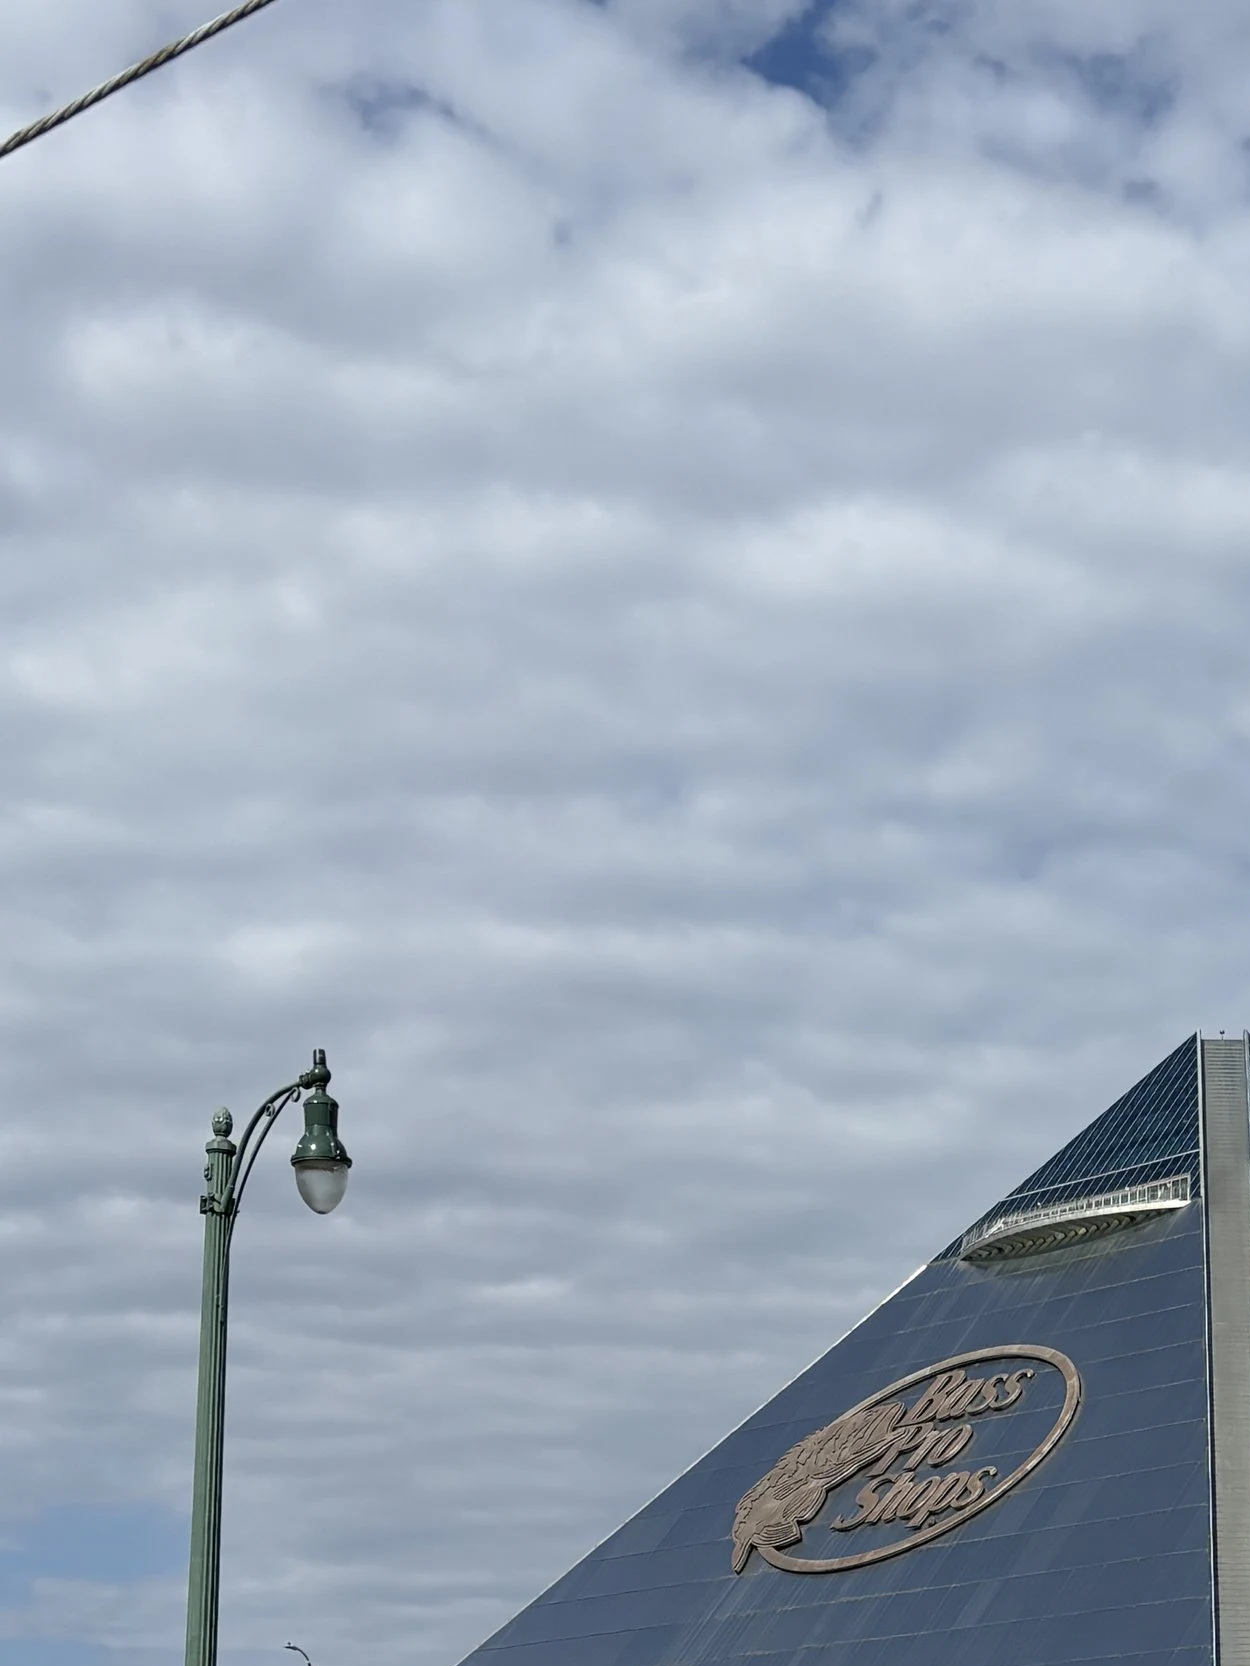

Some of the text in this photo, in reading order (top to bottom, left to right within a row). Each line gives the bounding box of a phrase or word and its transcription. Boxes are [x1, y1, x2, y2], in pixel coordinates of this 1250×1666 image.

[898, 1369, 1034, 1427] Bass
[866, 1422, 973, 1477] Pro
[831, 1466, 998, 1531] Shops
